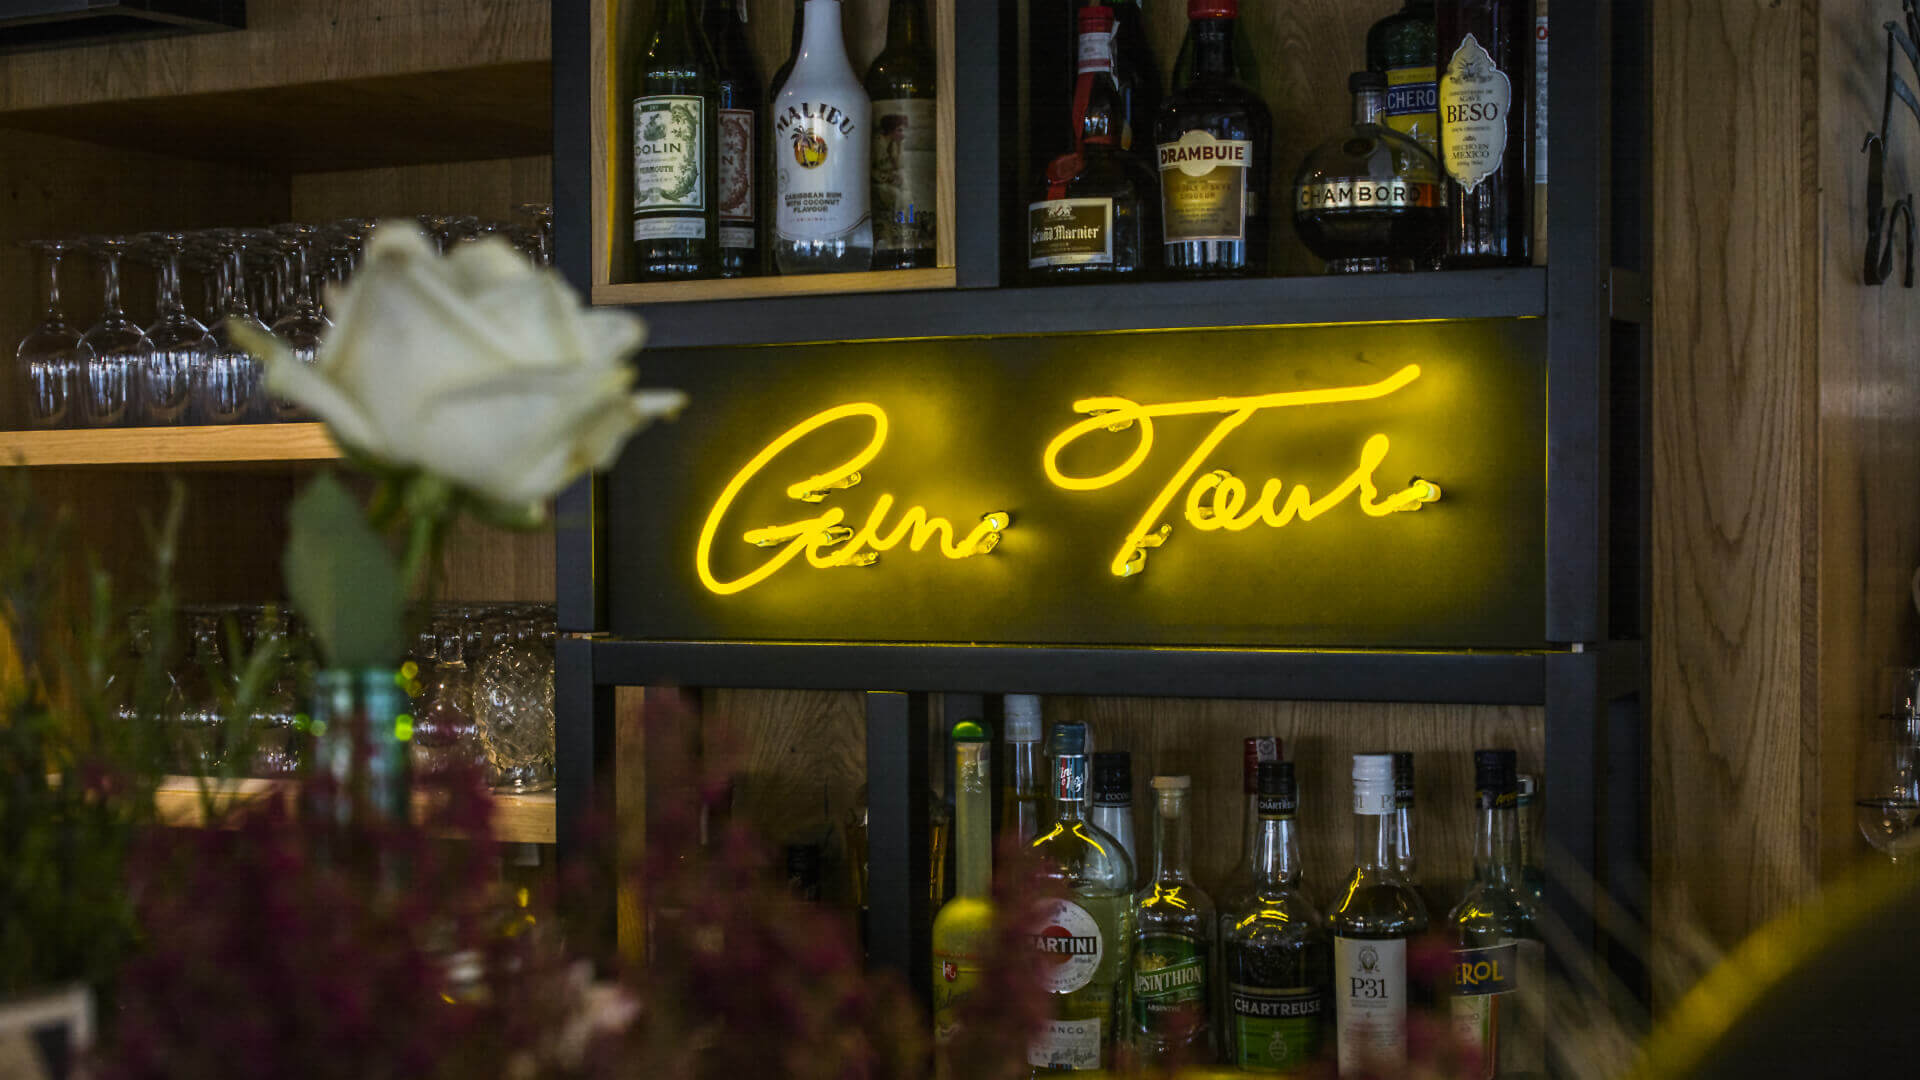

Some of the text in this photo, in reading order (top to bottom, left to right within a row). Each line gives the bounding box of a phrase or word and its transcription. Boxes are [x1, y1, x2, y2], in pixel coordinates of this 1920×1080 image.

[777, 102, 855, 138] MALIBU
[1447, 102, 1498, 123] BESO
[1160, 146, 1245, 164] DRAMBUIE
[1452, 151, 1490, 160] MEXICO
[1301, 186, 1421, 206] CHAMBORD
[1054, 224, 1100, 240] Marnier
[1044, 364, 1441, 577] Tour
[1350, 976, 1388, 999] P31
[1234, 998, 1320, 1016] CHARTREUSE
